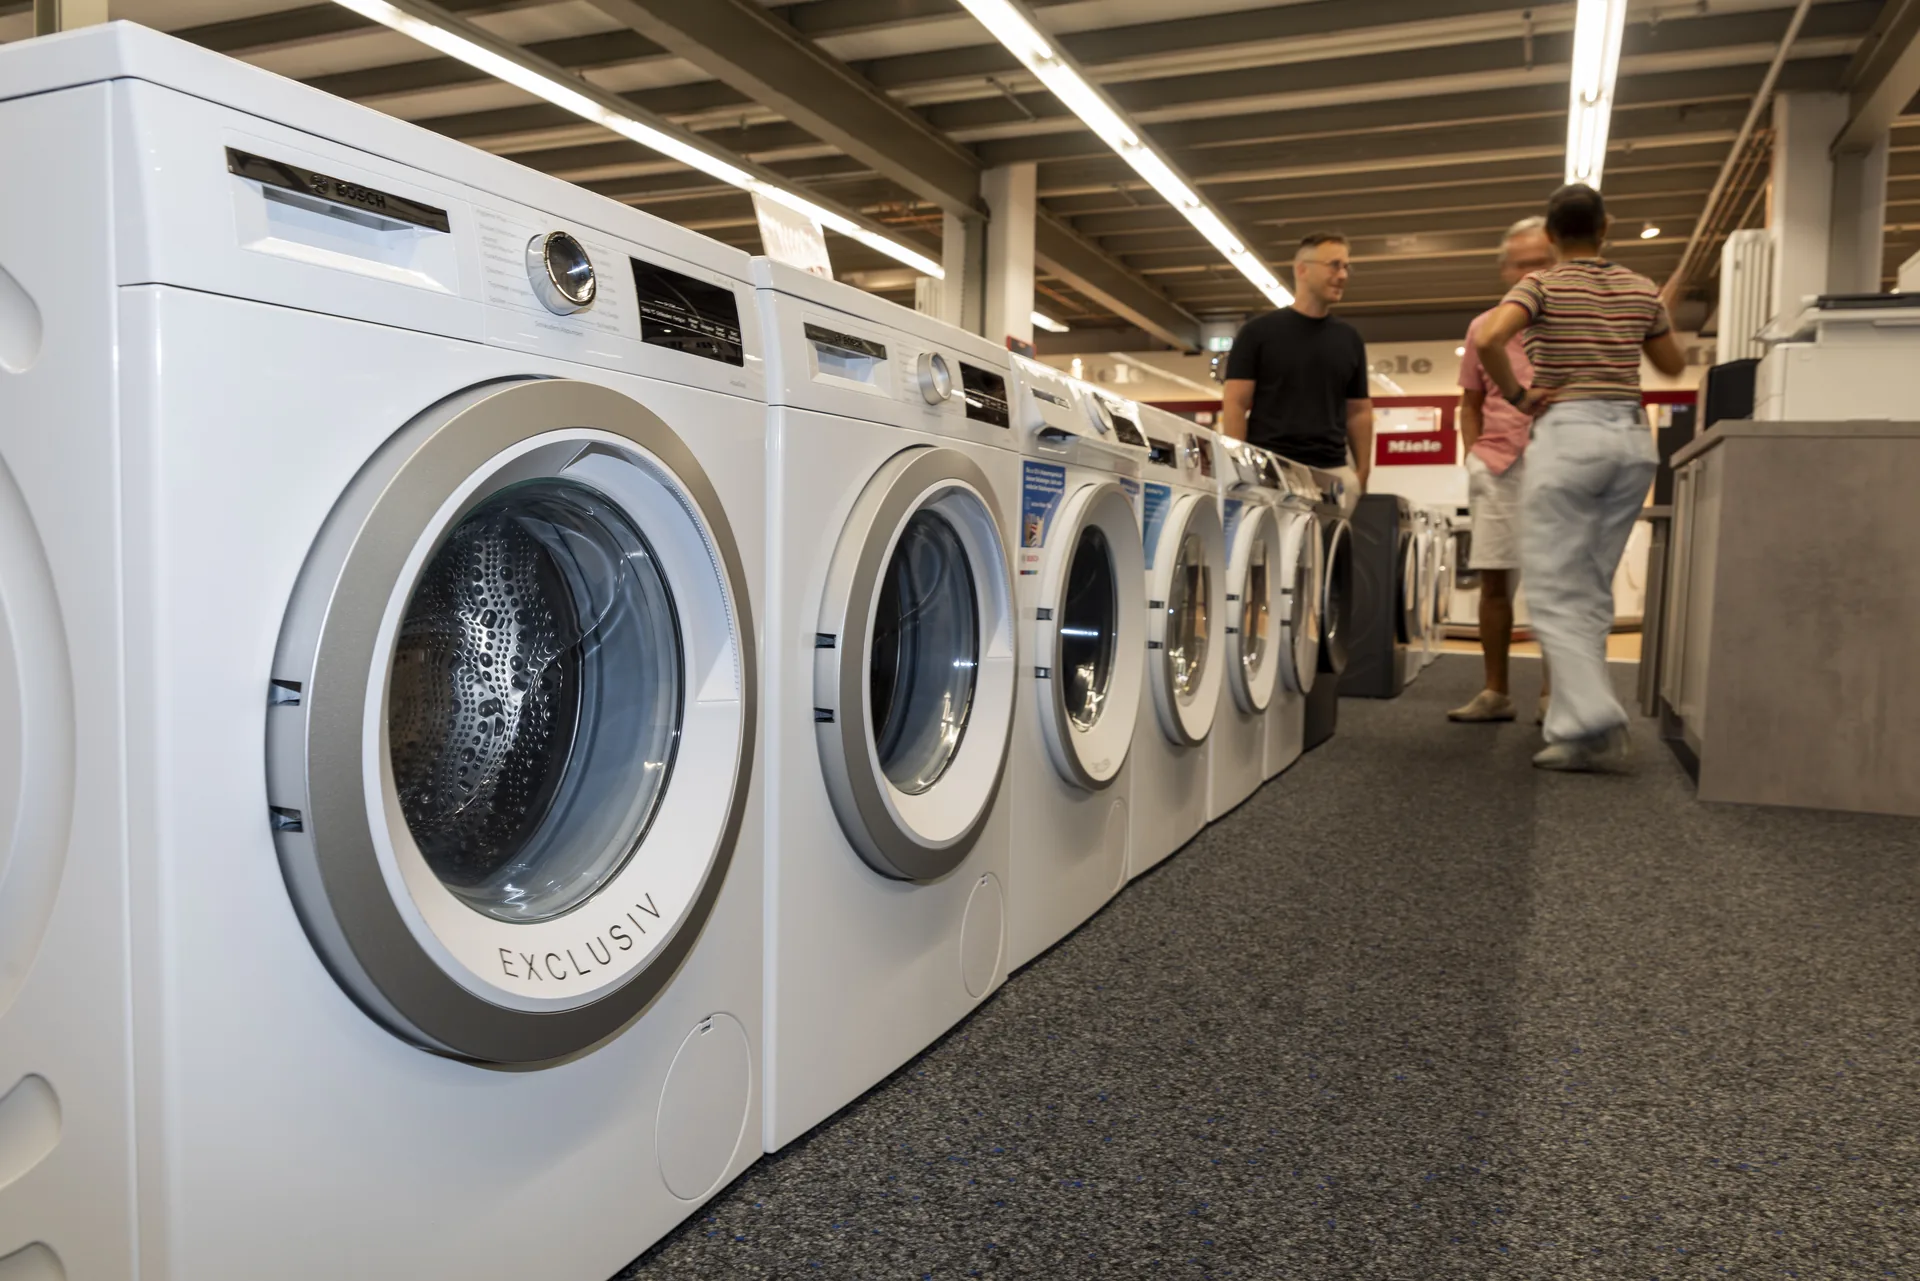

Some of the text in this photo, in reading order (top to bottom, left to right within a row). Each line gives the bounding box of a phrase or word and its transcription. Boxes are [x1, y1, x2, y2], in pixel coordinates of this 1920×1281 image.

[335, 182, 386, 209] BOSCH
[1387, 440, 1442, 453] Miele
[498, 892, 660, 981] EXCLUSIV
